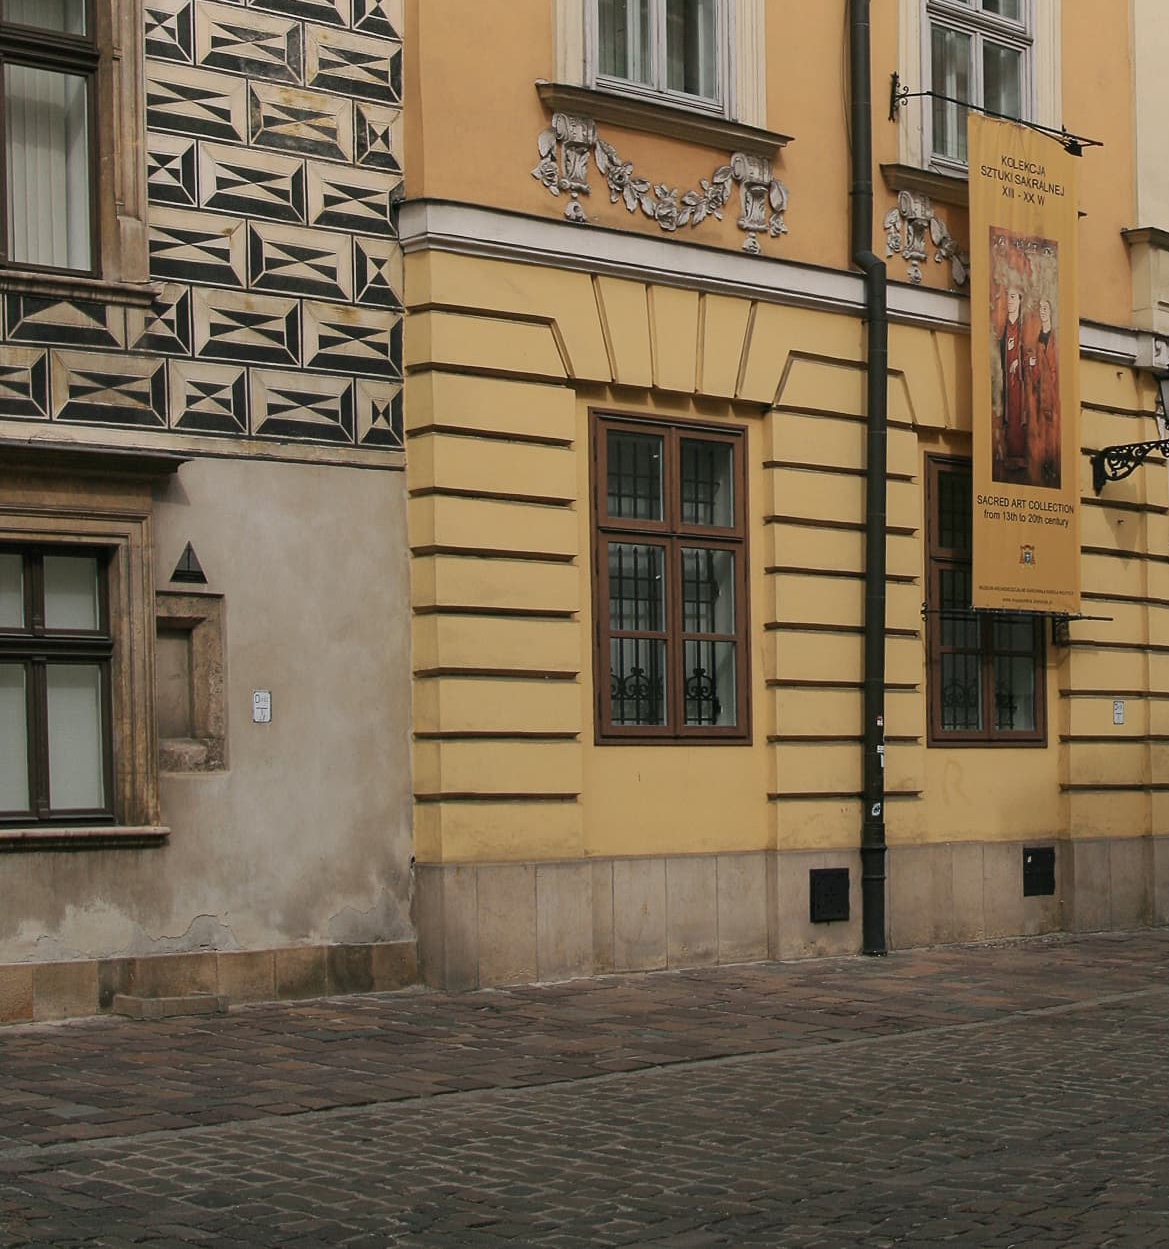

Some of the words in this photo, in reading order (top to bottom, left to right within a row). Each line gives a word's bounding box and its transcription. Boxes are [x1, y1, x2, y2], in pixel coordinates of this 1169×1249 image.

[1001, 155, 1046, 177] KOLEKCJA
[980, 165, 1013, 183] SZTUKI
[1014, 174, 1065, 196] SAKRALNEJ
[1023, 191, 1035, 204] XX
[977, 494, 1009, 507] SACRED
[1011, 498, 1026, 509] ART
[1028, 500, 1074, 513] COLLECTION
[983, 509, 1001, 519] from
[1002, 511, 1018, 521] 13th
[1019, 512, 1026, 522] to
[1028, 513, 1044, 524] 20th
[1044, 517, 1068, 528] century
